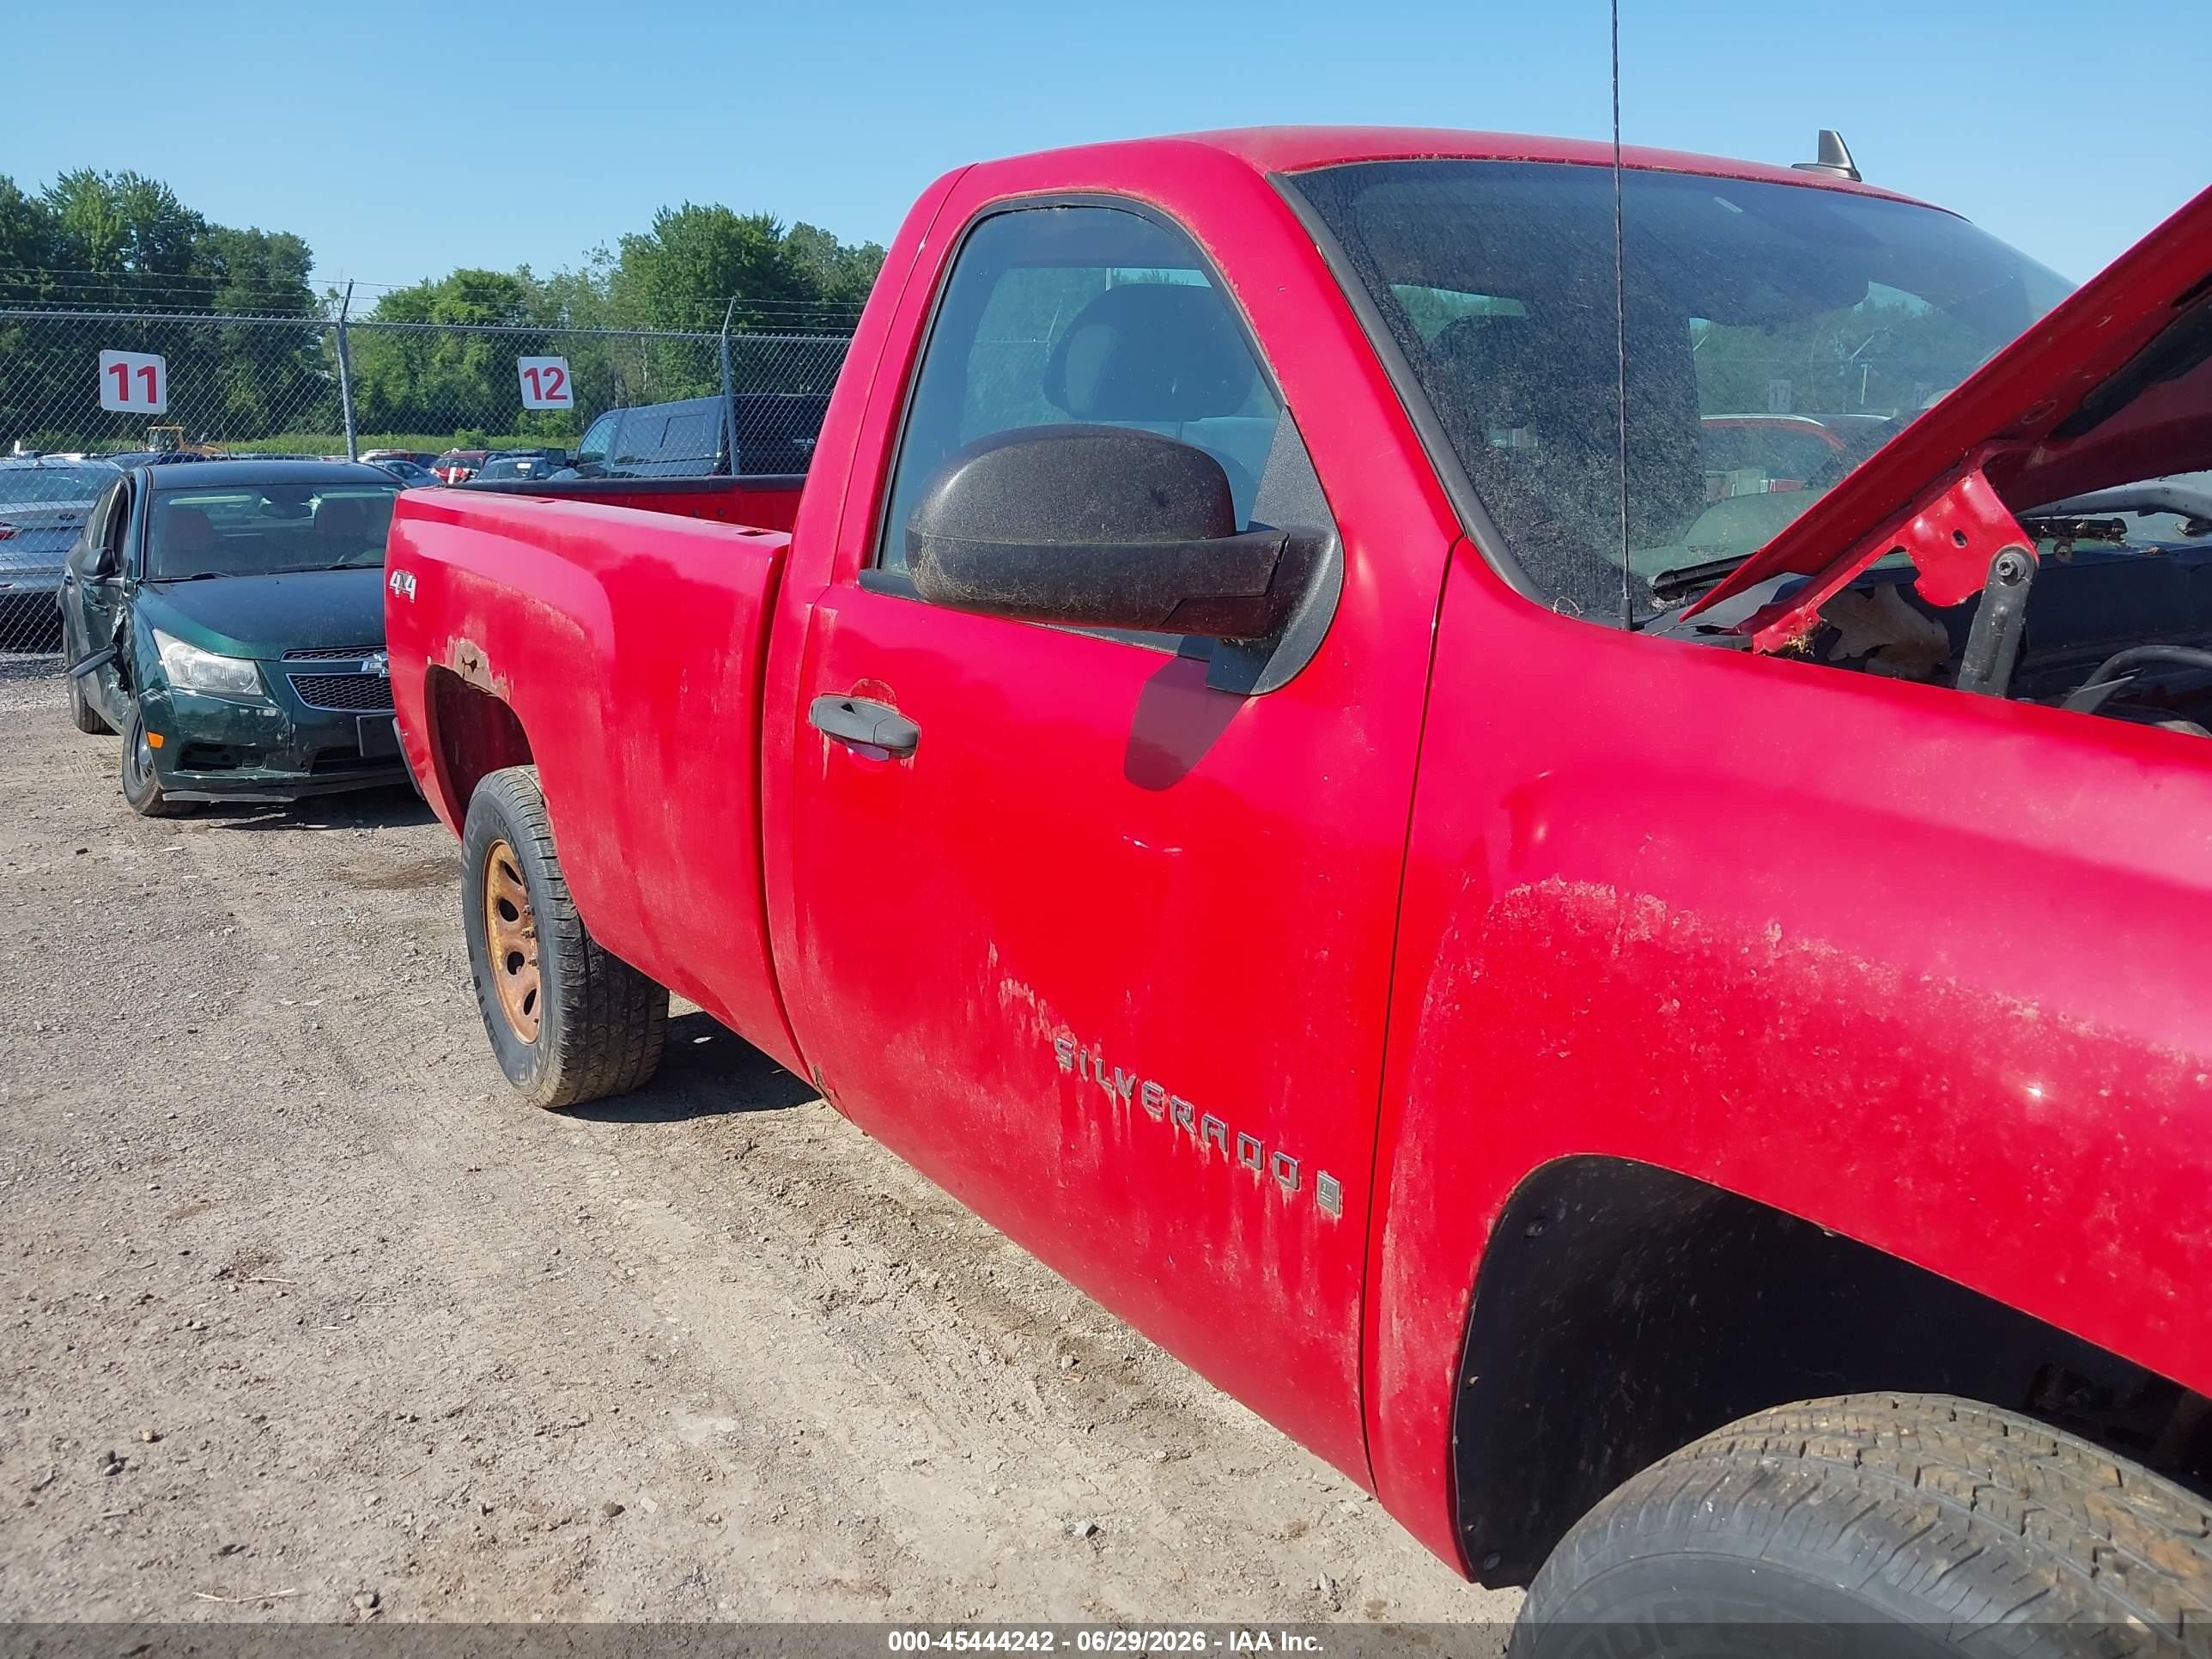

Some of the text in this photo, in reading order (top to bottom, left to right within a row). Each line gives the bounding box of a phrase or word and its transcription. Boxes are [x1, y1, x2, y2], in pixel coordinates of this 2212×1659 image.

[108, 362, 157, 404] 11
[523, 367, 568, 400] 12
[1054, 1036, 1300, 1191] SILVERADO
